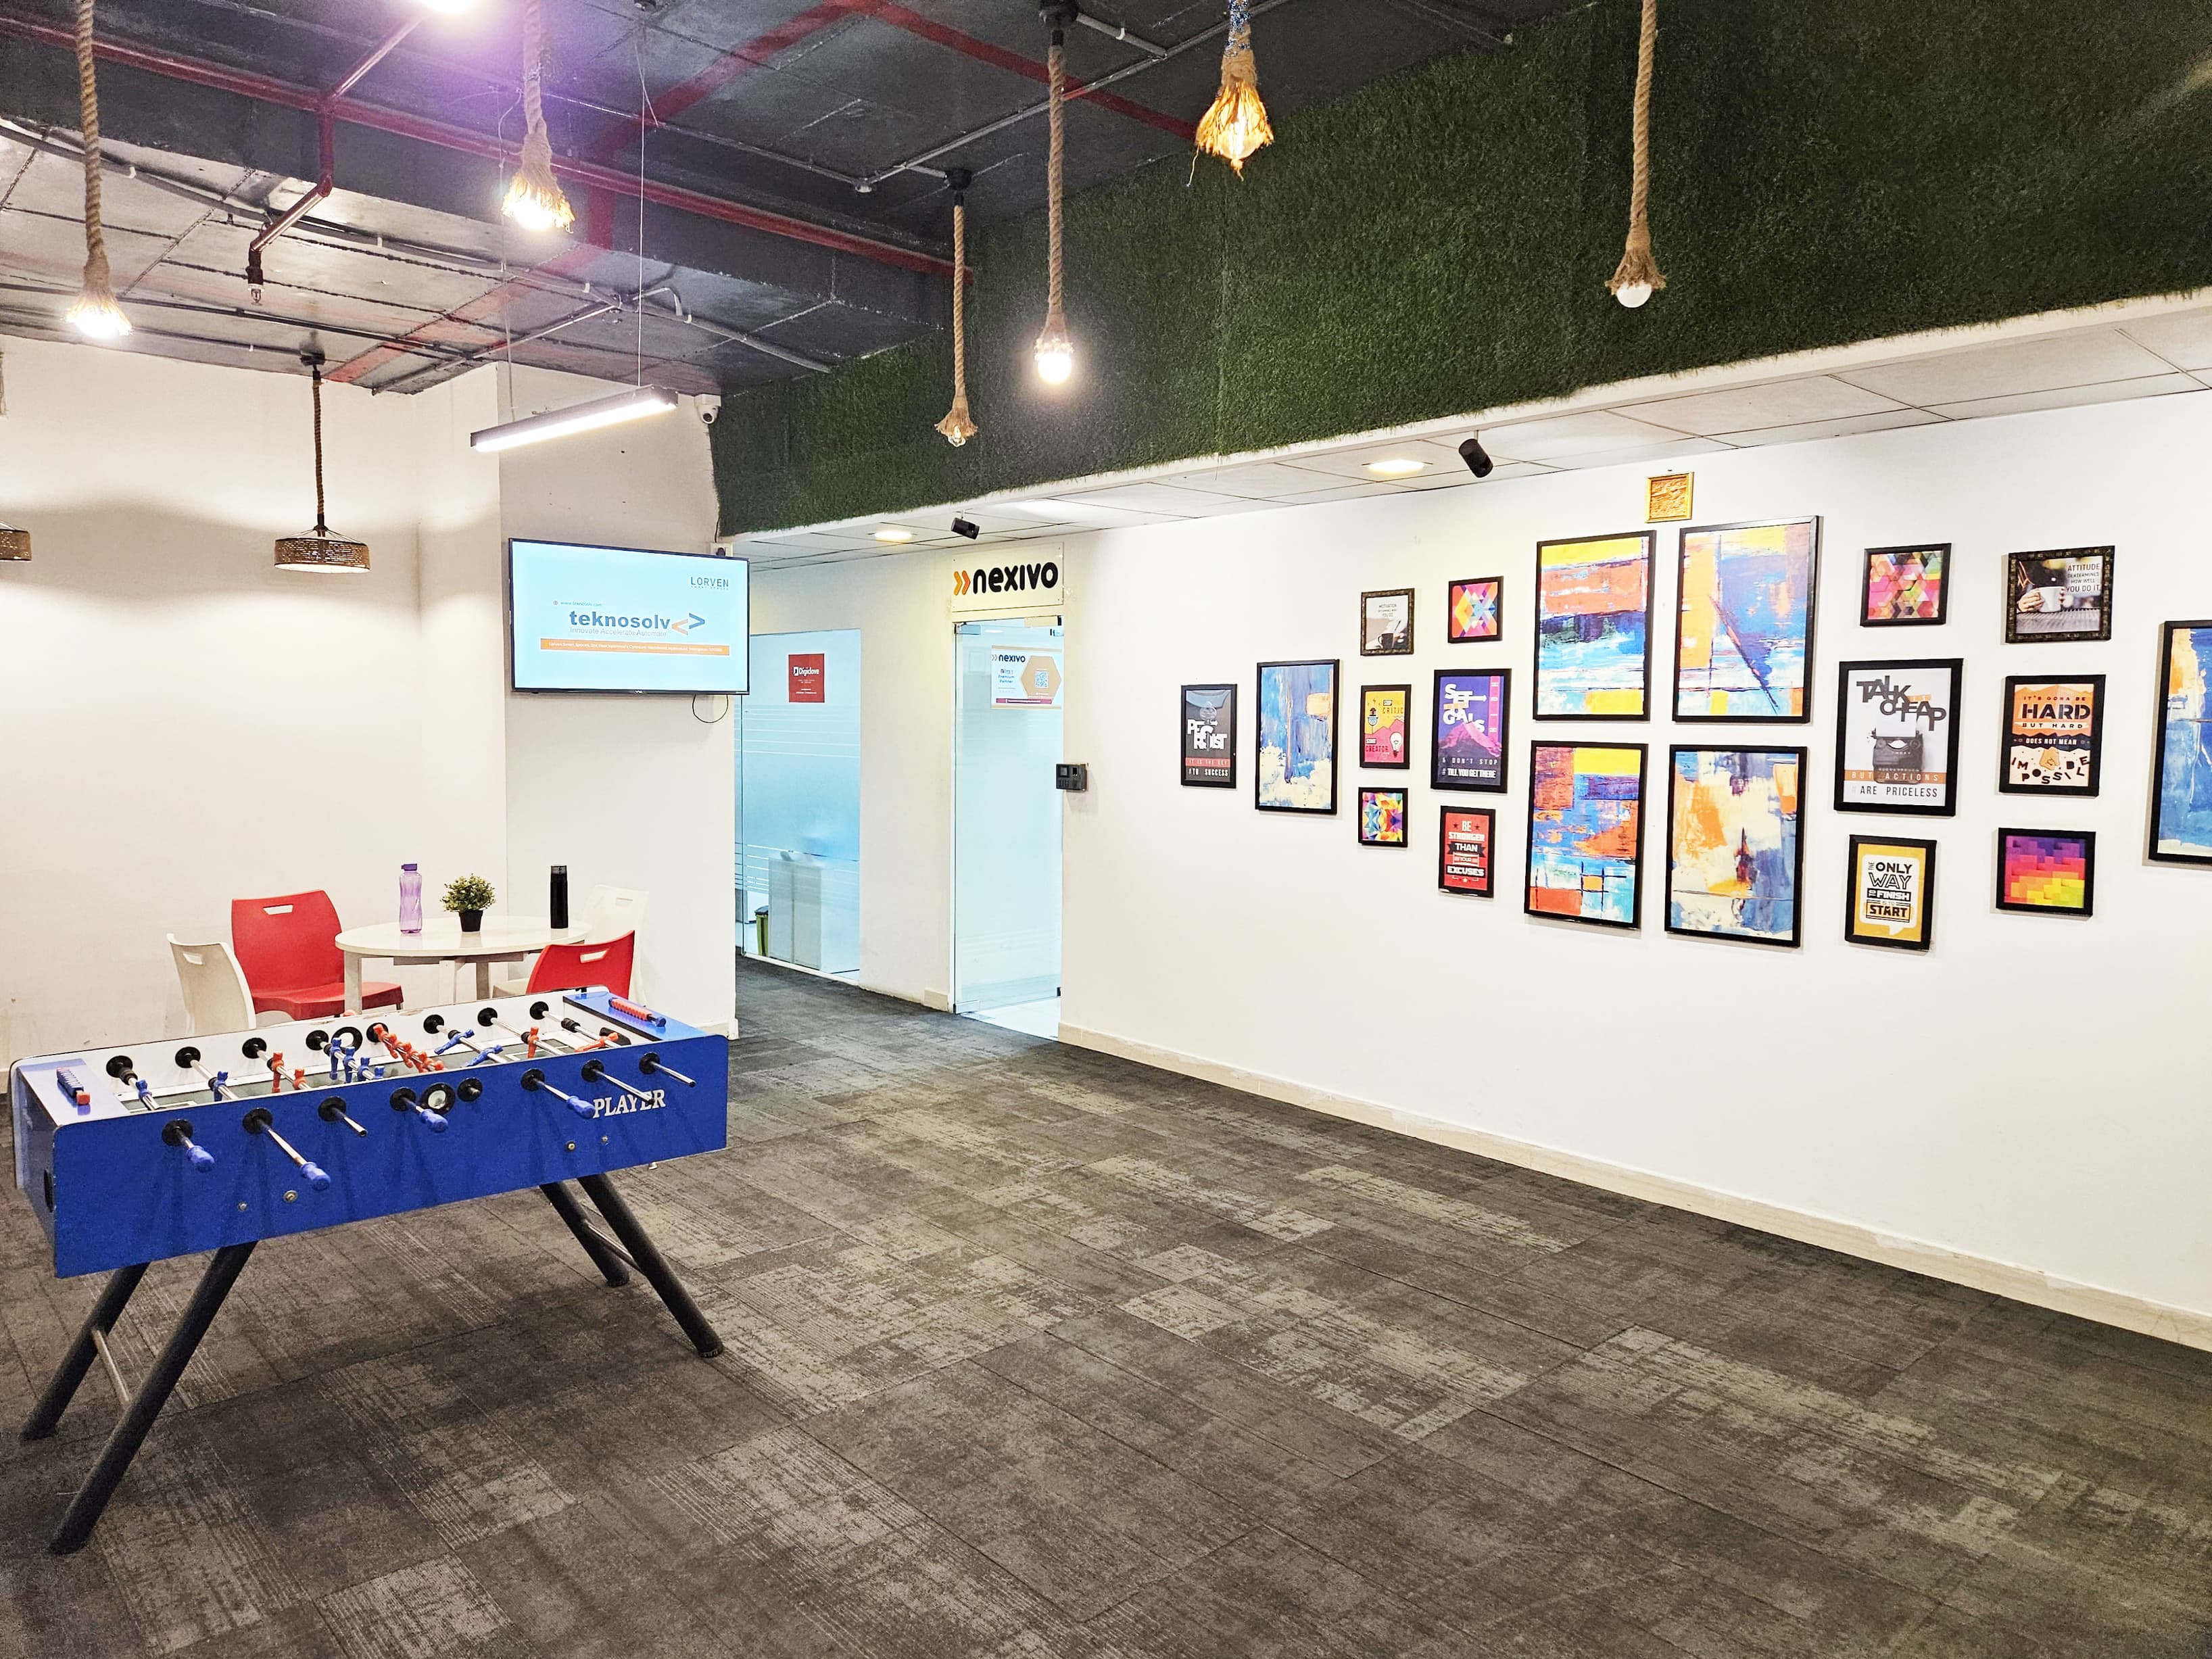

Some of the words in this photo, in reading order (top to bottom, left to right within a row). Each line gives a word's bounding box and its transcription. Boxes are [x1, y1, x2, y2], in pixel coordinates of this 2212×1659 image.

[2068, 563, 2100, 571] ATTITUDE
[691, 576, 729, 587] LORVEN
[973, 562, 1058, 594] nexivo
[569, 610, 671, 629] teknosolv
[999, 654, 1026, 663] nexivo
[1856, 675, 1911, 704] TALK
[1879, 699, 1947, 731] CHEAP
[2022, 703, 2090, 719] HARD
[1205, 768, 1228, 777] SUCCESS
[1458, 768, 1469, 777] YOU
[1469, 769, 1479, 777] GET
[1479, 769, 1497, 779] THERE
[1885, 773, 1938, 781] ACTIONS
[1860, 786, 1877, 795] ARE
[1886, 786, 1938, 797] PRICELESS
[1462, 820, 1472, 832] BE
[1448, 832, 1485, 842] STRONGER
[1455, 842, 1478, 852] THAN
[1447, 865, 1485, 877] EXCUSES
[1875, 861, 1913, 874] ONLY
[1869, 872, 1913, 890] WAY
[1877, 891, 1910, 900] FINISH
[1869, 905, 1908, 917] START
